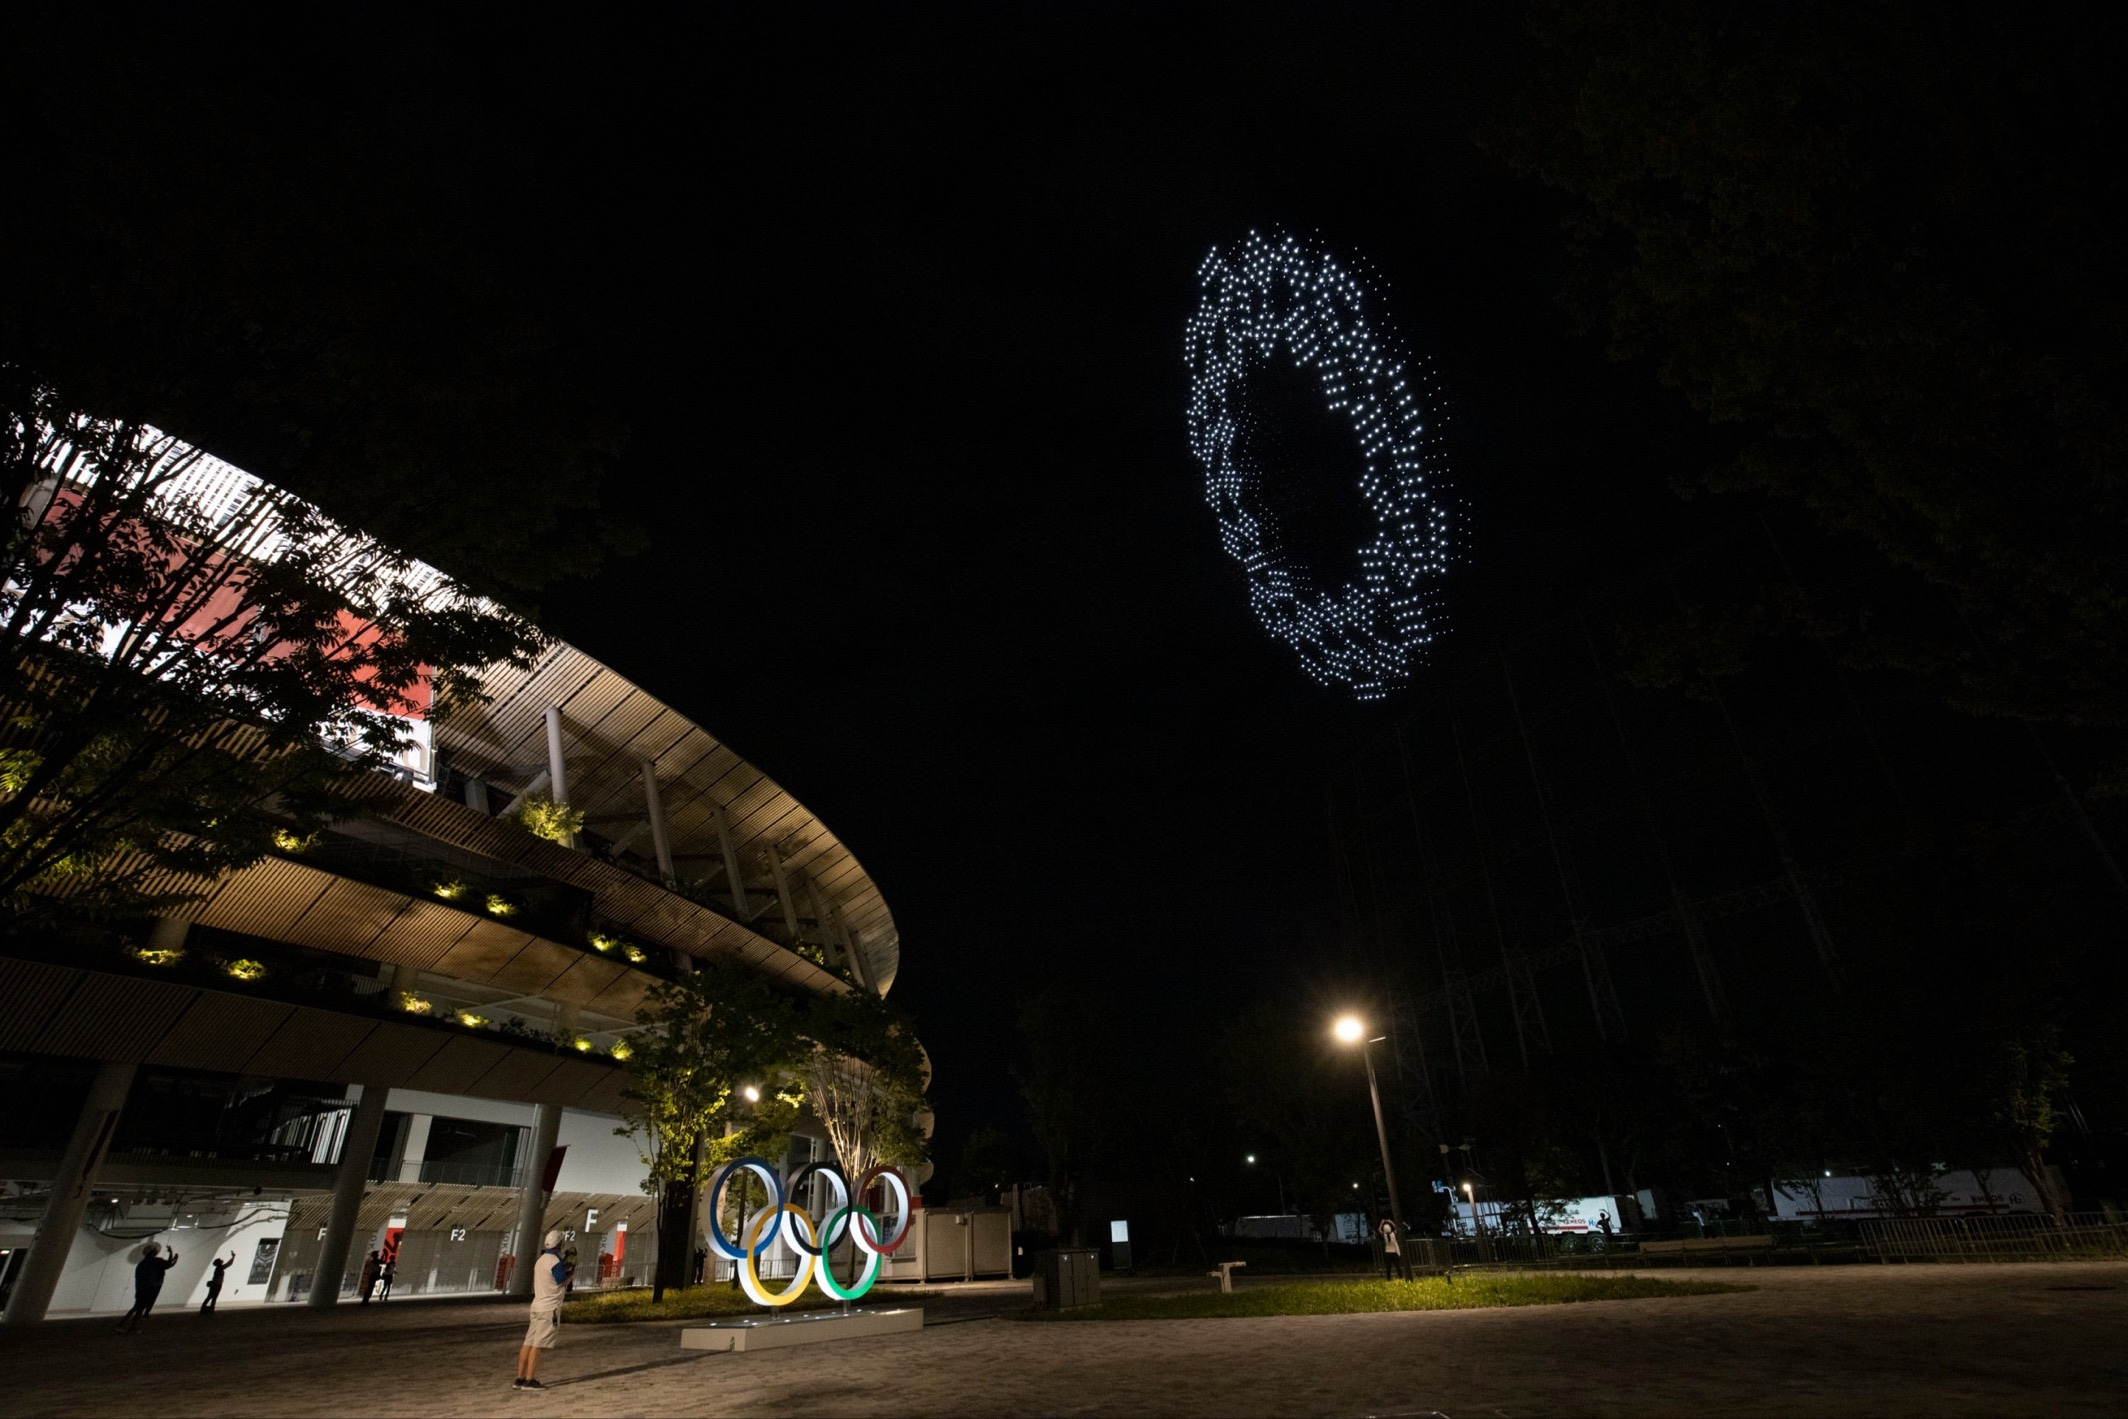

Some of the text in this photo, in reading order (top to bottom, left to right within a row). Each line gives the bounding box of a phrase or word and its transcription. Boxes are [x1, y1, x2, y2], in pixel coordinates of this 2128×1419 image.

[584, 1208, 599, 1233] F
[450, 1229, 466, 1241] F2
[564, 1230, 576, 1242] F2
